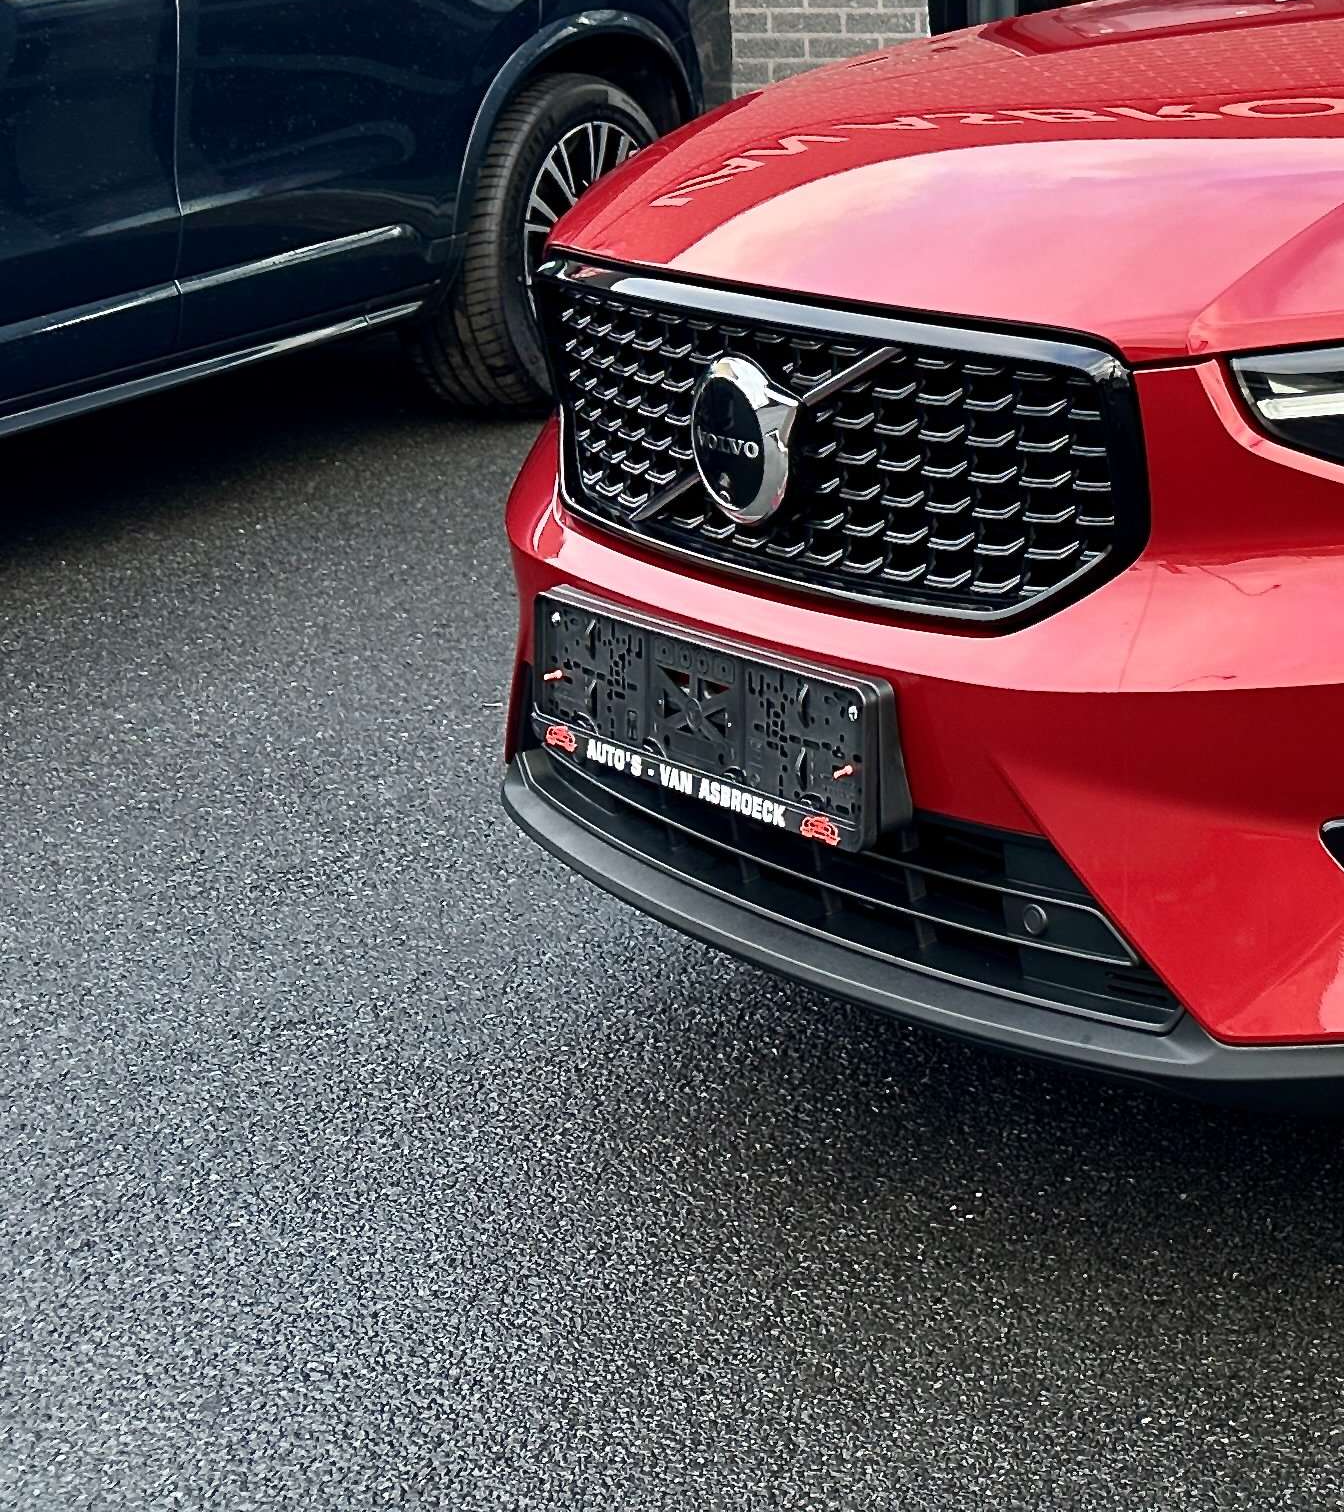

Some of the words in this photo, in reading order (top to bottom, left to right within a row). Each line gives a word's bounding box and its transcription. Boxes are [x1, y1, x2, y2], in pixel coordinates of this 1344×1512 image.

[696, 425, 760, 459] VOLVO
[586, 738, 643, 778] AUTO'S
[659, 764, 694, 796] VAN
[698, 777, 787, 829] ASBROECK
